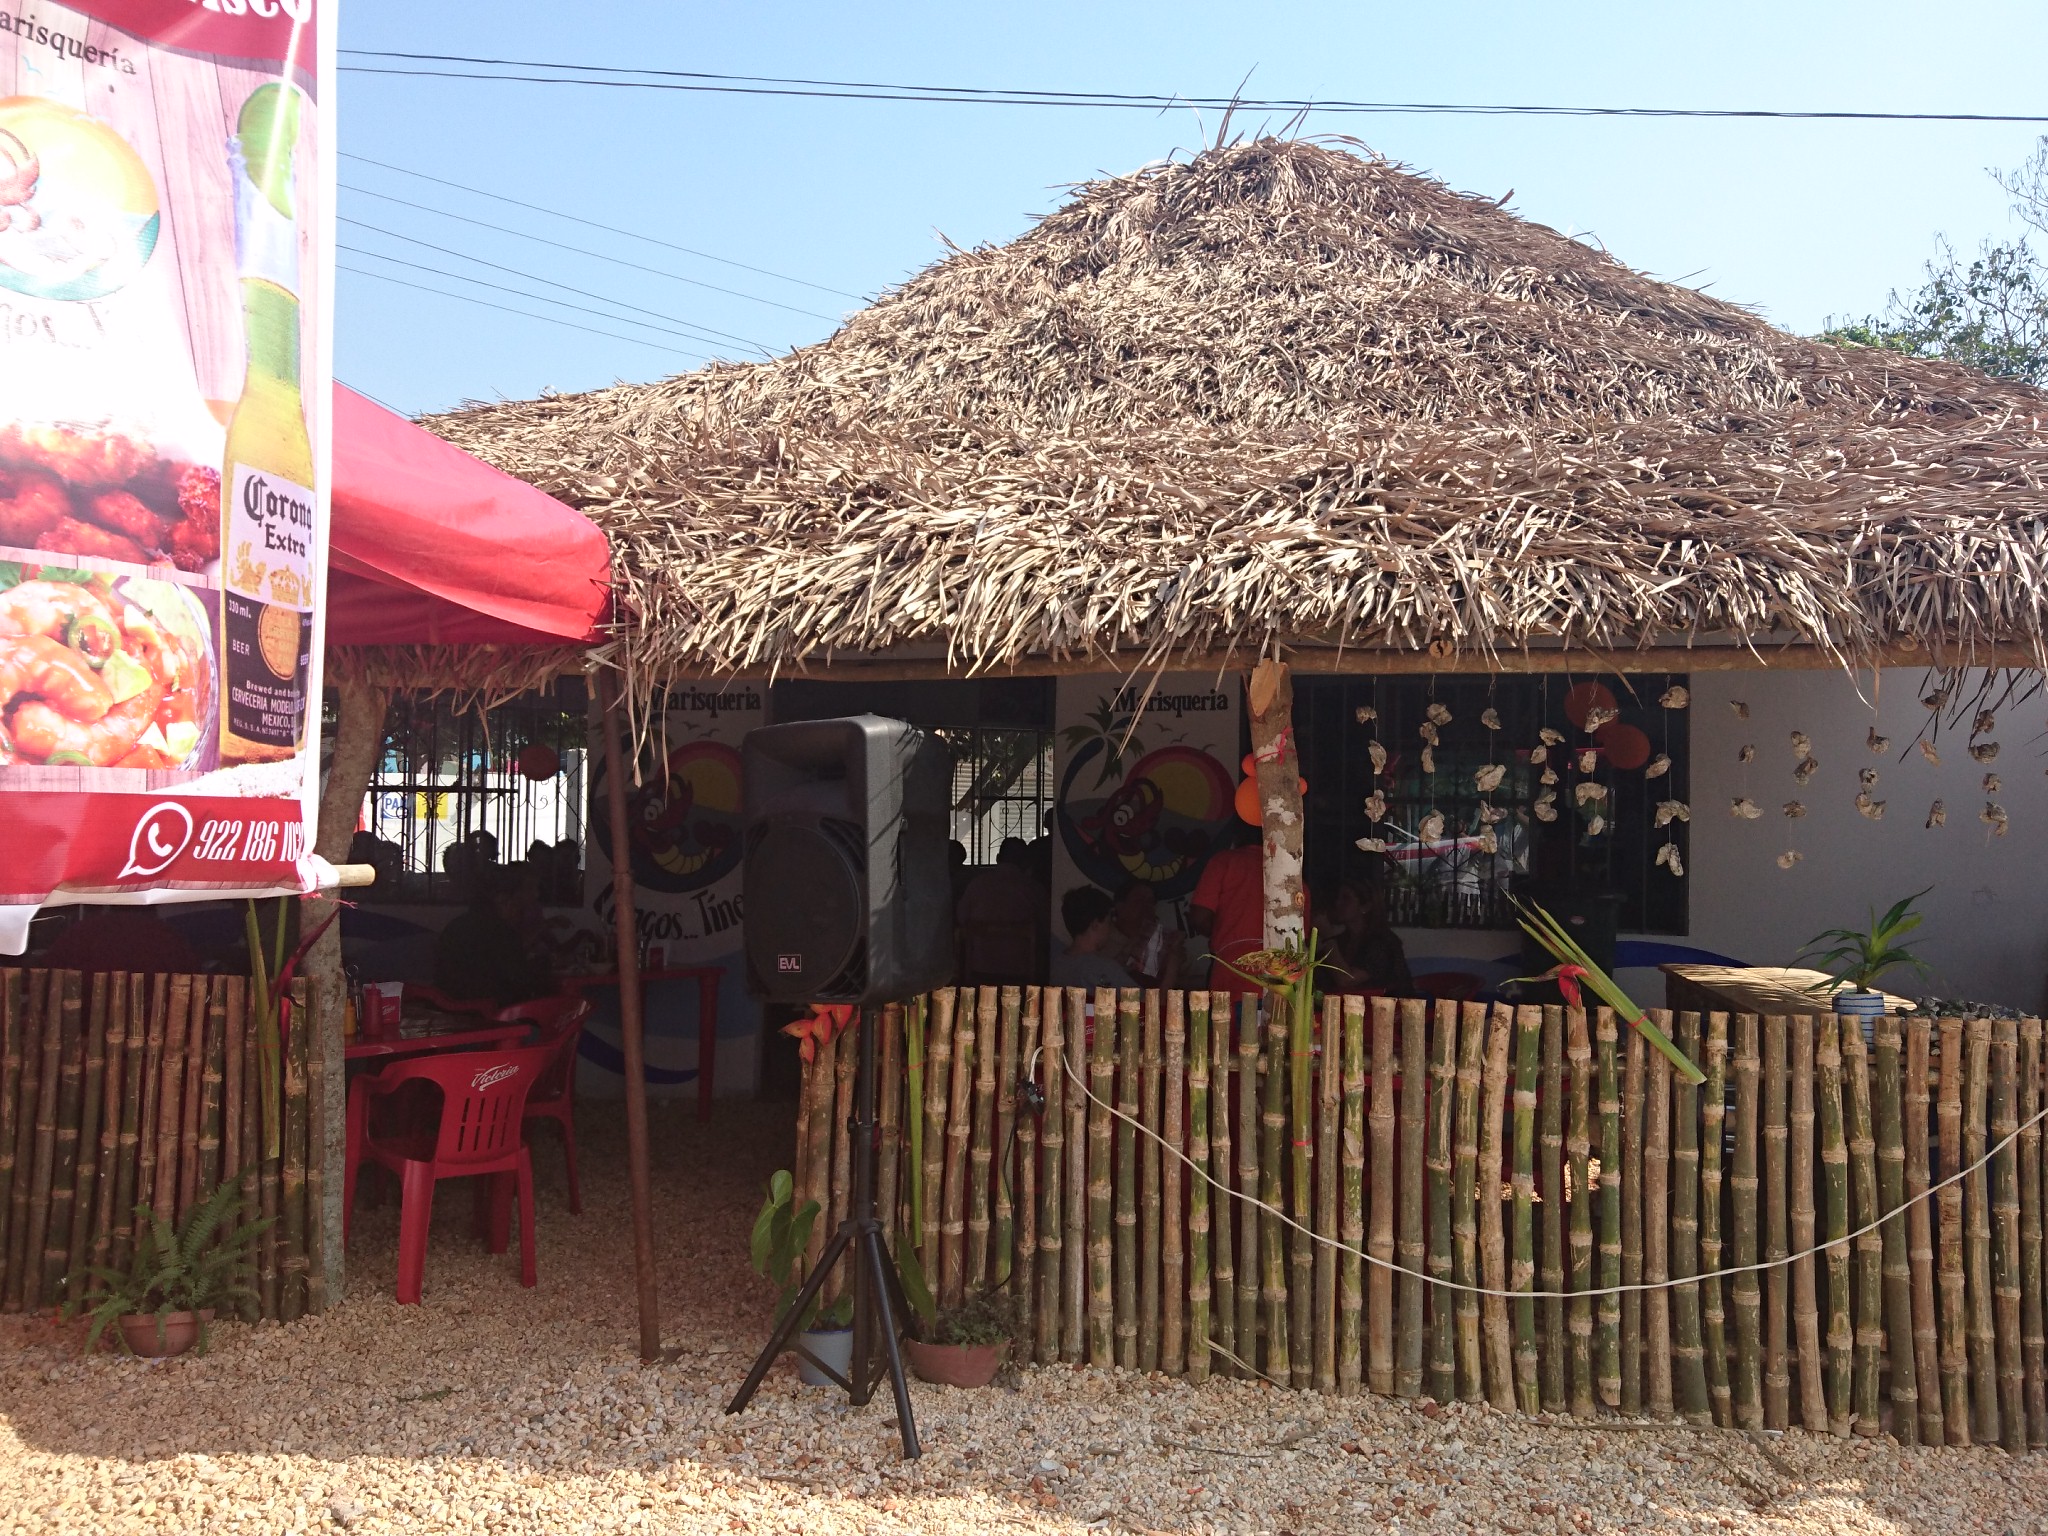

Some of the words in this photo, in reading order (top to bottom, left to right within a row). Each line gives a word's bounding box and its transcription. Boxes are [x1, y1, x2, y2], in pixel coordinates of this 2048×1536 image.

[265, 523, 306, 558] Extra
[229, 599, 239, 614] 330
[232, 639, 250, 656] BEER
[246, 680, 272, 695] Brewed
[274, 688, 287, 698] and
[193, 819, 243, 860] 922
[240, 820, 279, 862] 186
[779, 957, 800, 970] EVL
[470, 1062, 520, 1092] Victoria
